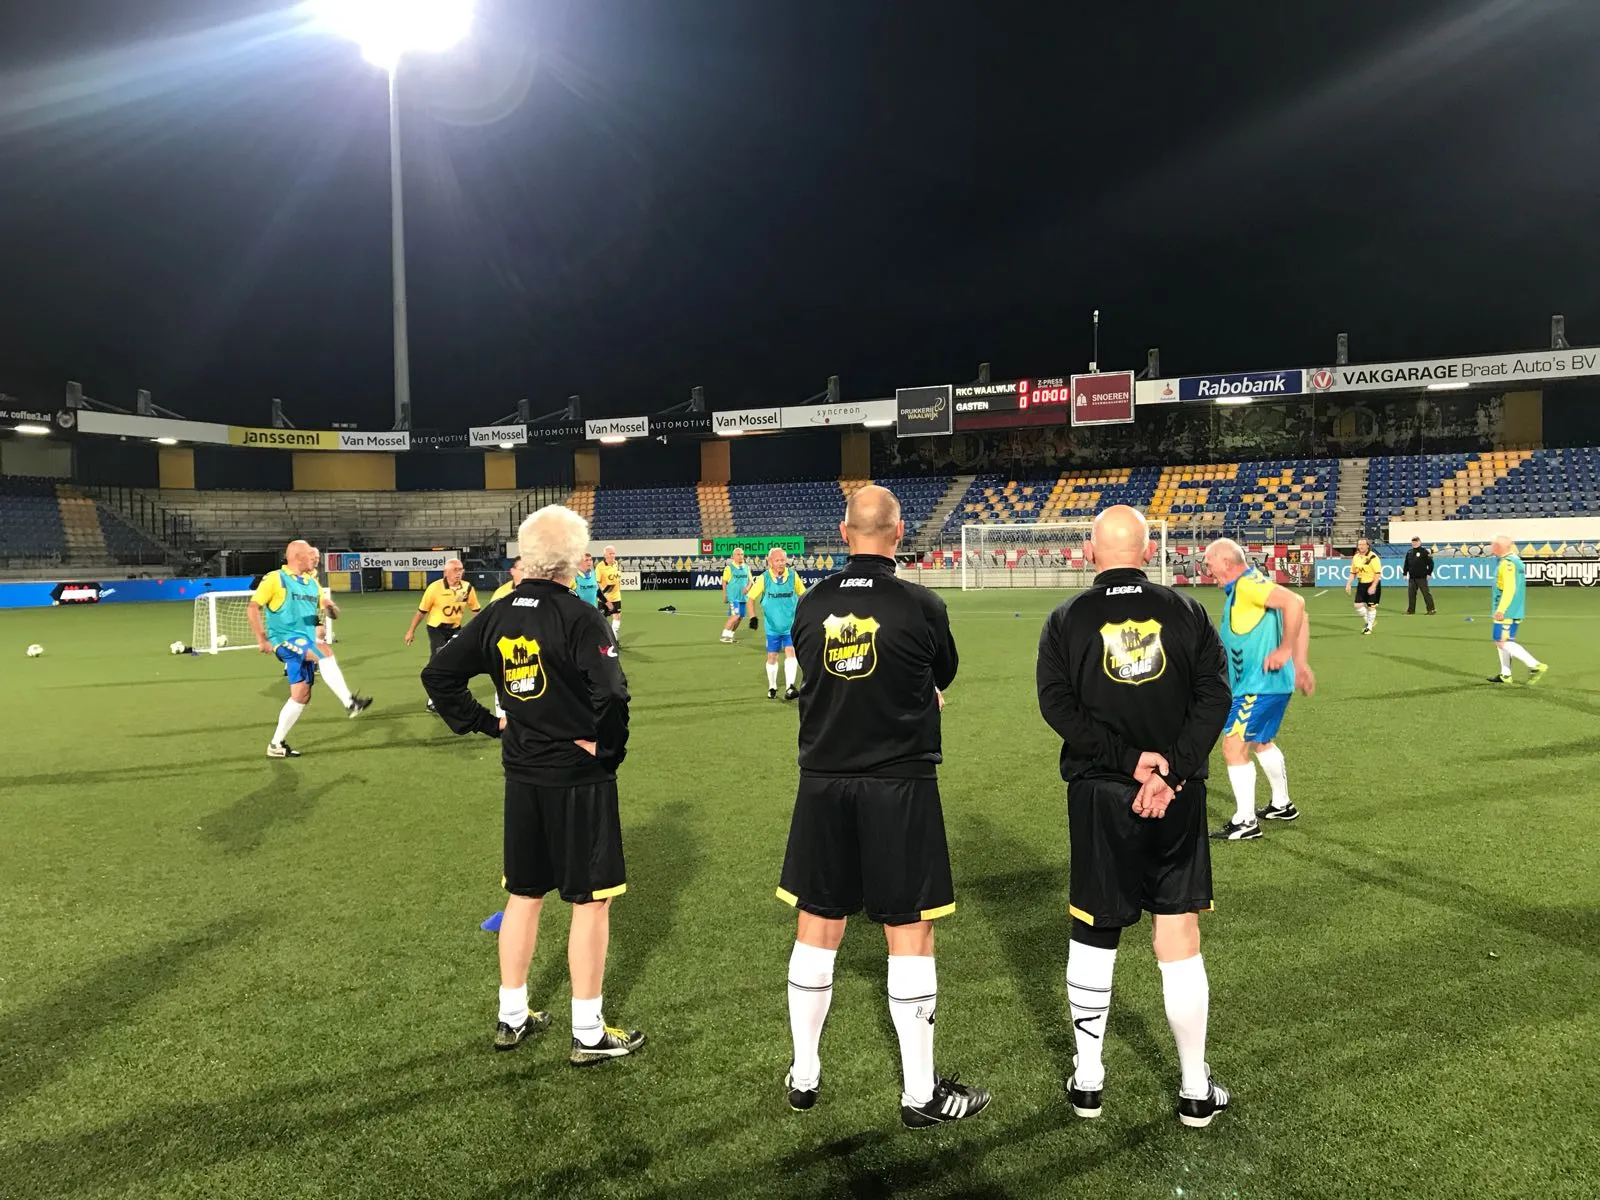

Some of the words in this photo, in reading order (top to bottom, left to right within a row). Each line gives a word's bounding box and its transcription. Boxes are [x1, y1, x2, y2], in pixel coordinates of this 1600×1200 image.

[1343, 365, 1457, 385] VAKGARAGE
[1461, 363, 1508, 378] Braat
[1512, 357, 1566, 374] Auto's
[1571, 354, 1597, 370] BV
[956, 387, 973, 396] RKC
[974, 383, 1017, 395] WAALWIJK
[1198, 376, 1286, 397] Rabobank
[1092, 391, 1129, 402] SNOEREN
[817, 406, 860, 417] syncreon
[956, 402, 989, 412] GASTEN
[716, 417, 736, 427] Van
[738, 412, 777, 426] Mossel
[588, 423, 607, 434] Van
[609, 420, 645, 432] Mossel
[649, 419, 711, 430] AUTOMOTIVE
[342, 435, 363, 446] Van
[366, 435, 406, 446] Mossel
[411, 434, 468, 444] AUTOMOTIVE
[472, 431, 489, 441] Van
[492, 428, 524, 440] Mossel
[528, 427, 584, 437] AUTOMOTIVE
[363, 558, 392, 567] Steen
[394, 559, 410, 567] van
[412, 556, 446, 569] Breugel
[839, 578, 874, 588] LEGEA
[1106, 586, 1142, 595] LEGEA
[828, 642, 871, 663] TEAMPLAY
